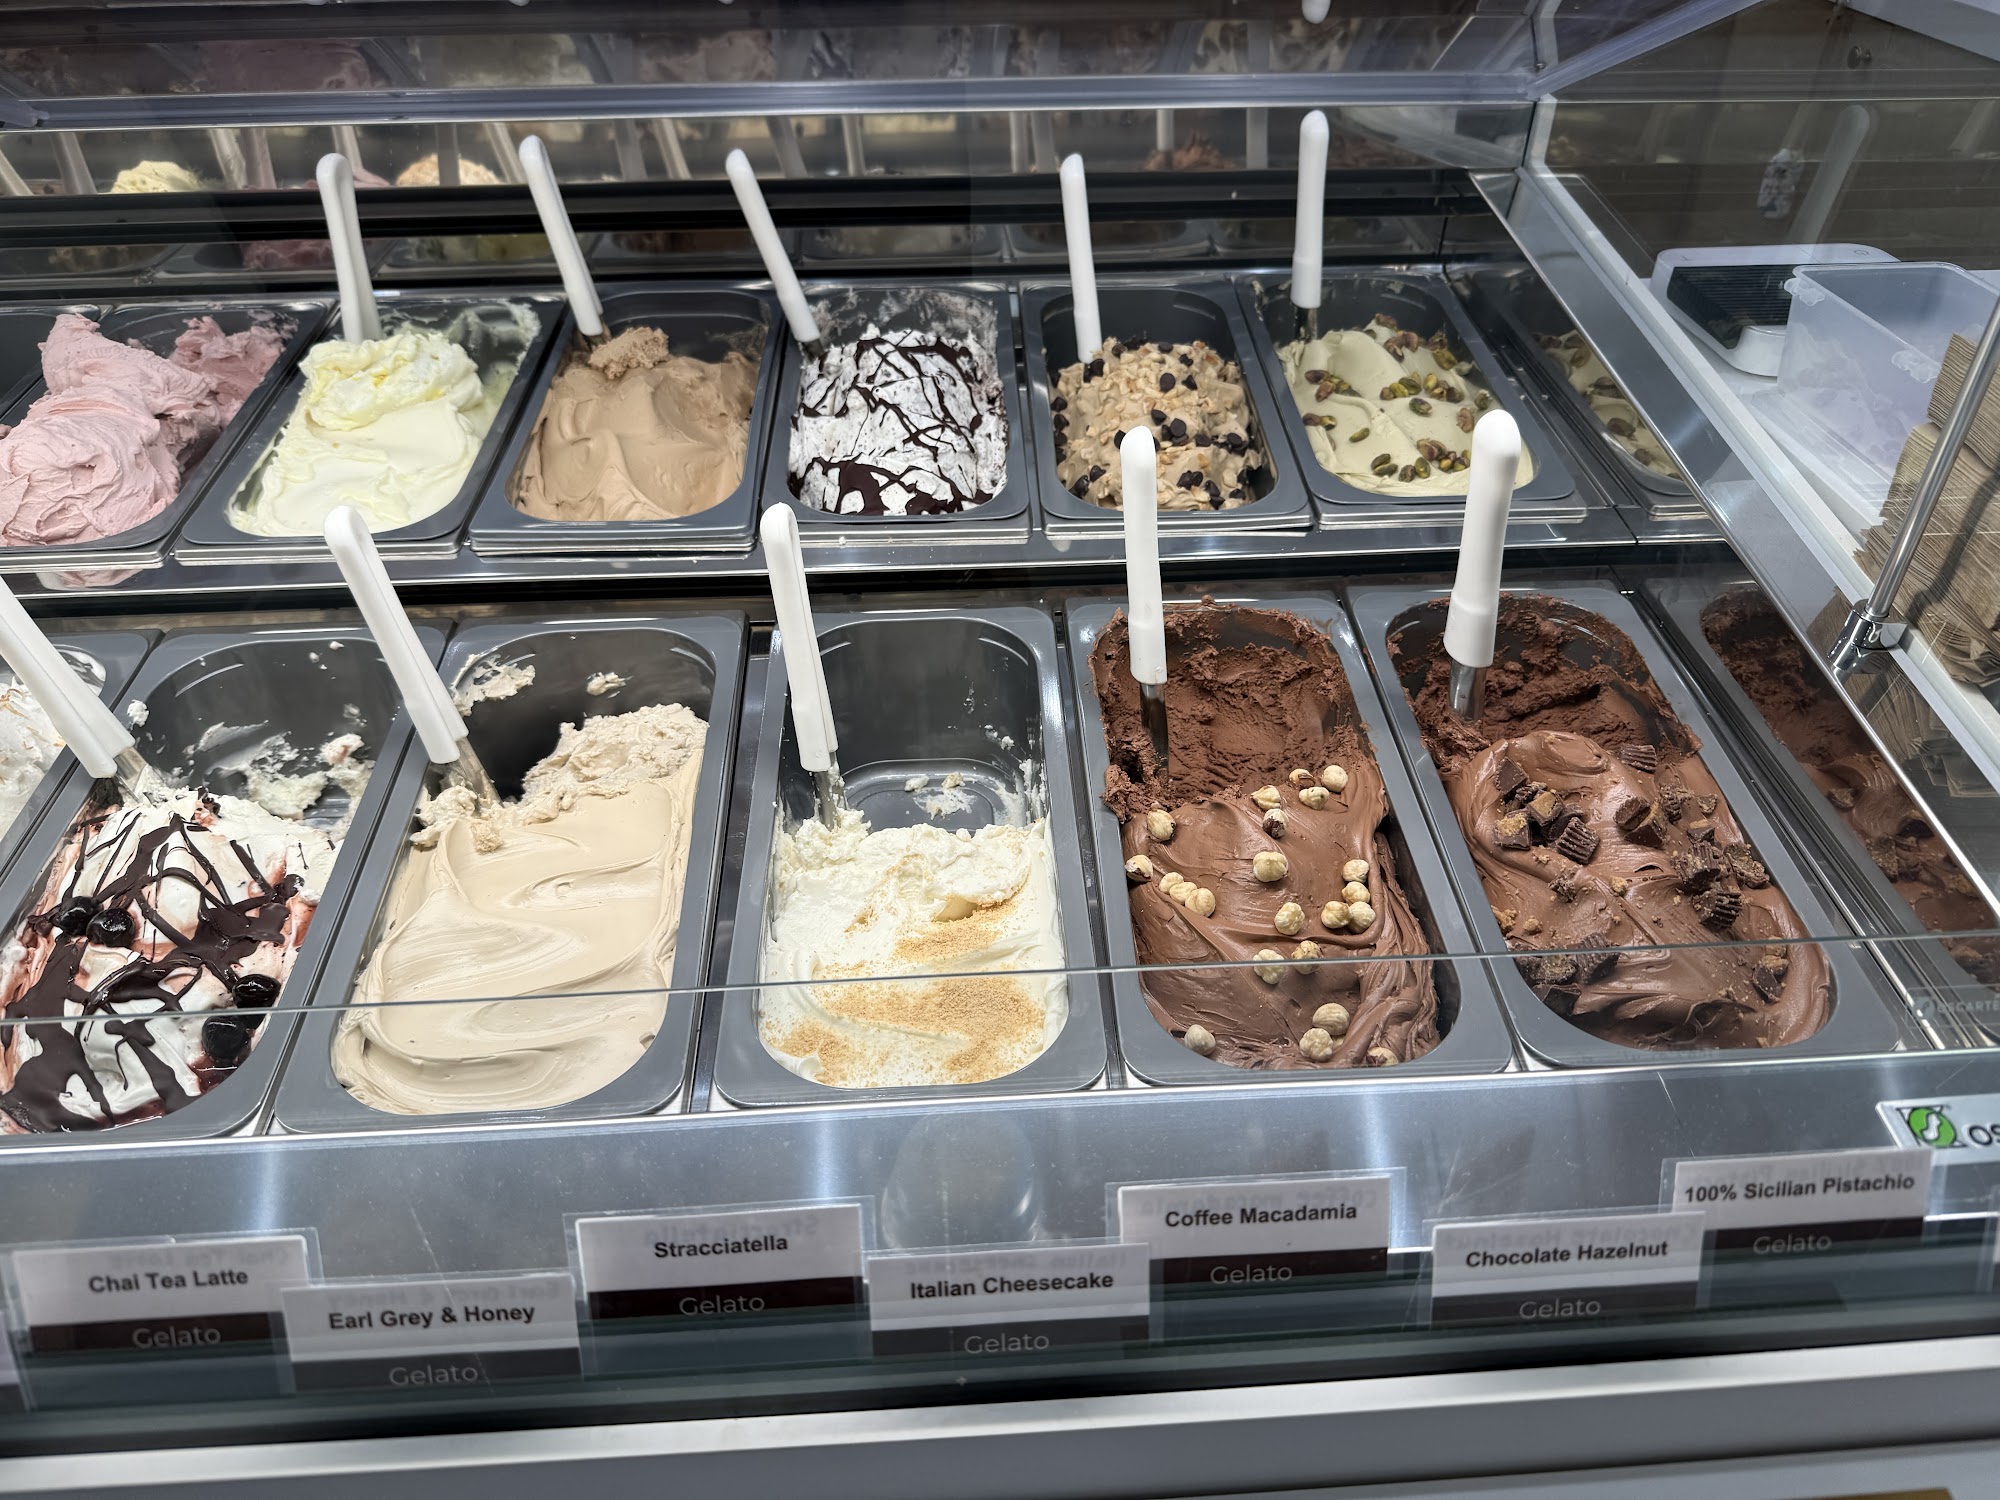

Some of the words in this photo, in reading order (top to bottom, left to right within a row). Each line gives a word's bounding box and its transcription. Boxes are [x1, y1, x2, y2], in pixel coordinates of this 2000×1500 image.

[1685, 1184, 1737, 1203] 100%
[1744, 1178, 1816, 1200] Sicilian
[1822, 1173, 1915, 1194] Pistachio
[1165, 1211, 1234, 1228] Coffee
[1240, 1203, 1358, 1225] Macadamia
[654, 1235, 789, 1259] Stracciatella
[1466, 1247, 1571, 1268] Chocolate
[1577, 1239, 1669, 1262] Hazelnut
[1753, 1233, 1832, 1256] Gelato
[88, 1274, 140, 1294] Chai
[145, 1273, 186, 1291] Tea
[193, 1268, 249, 1287] Latte
[910, 1279, 975, 1299] Italian
[983, 1272, 1114, 1295] Cheesecake
[1210, 1264, 1293, 1286] Gelato
[328, 1311, 374, 1330] Earl
[380, 1309, 433, 1329] Grey
[442, 1306, 458, 1323] &
[464, 1304, 535, 1325] Honey
[679, 1294, 766, 1316] Gelato
[1518, 1298, 1601, 1321] Gelato
[132, 1325, 222, 1349] Gelato
[963, 1333, 1050, 1355] Gelato
[389, 1362, 479, 1386] Gelato
